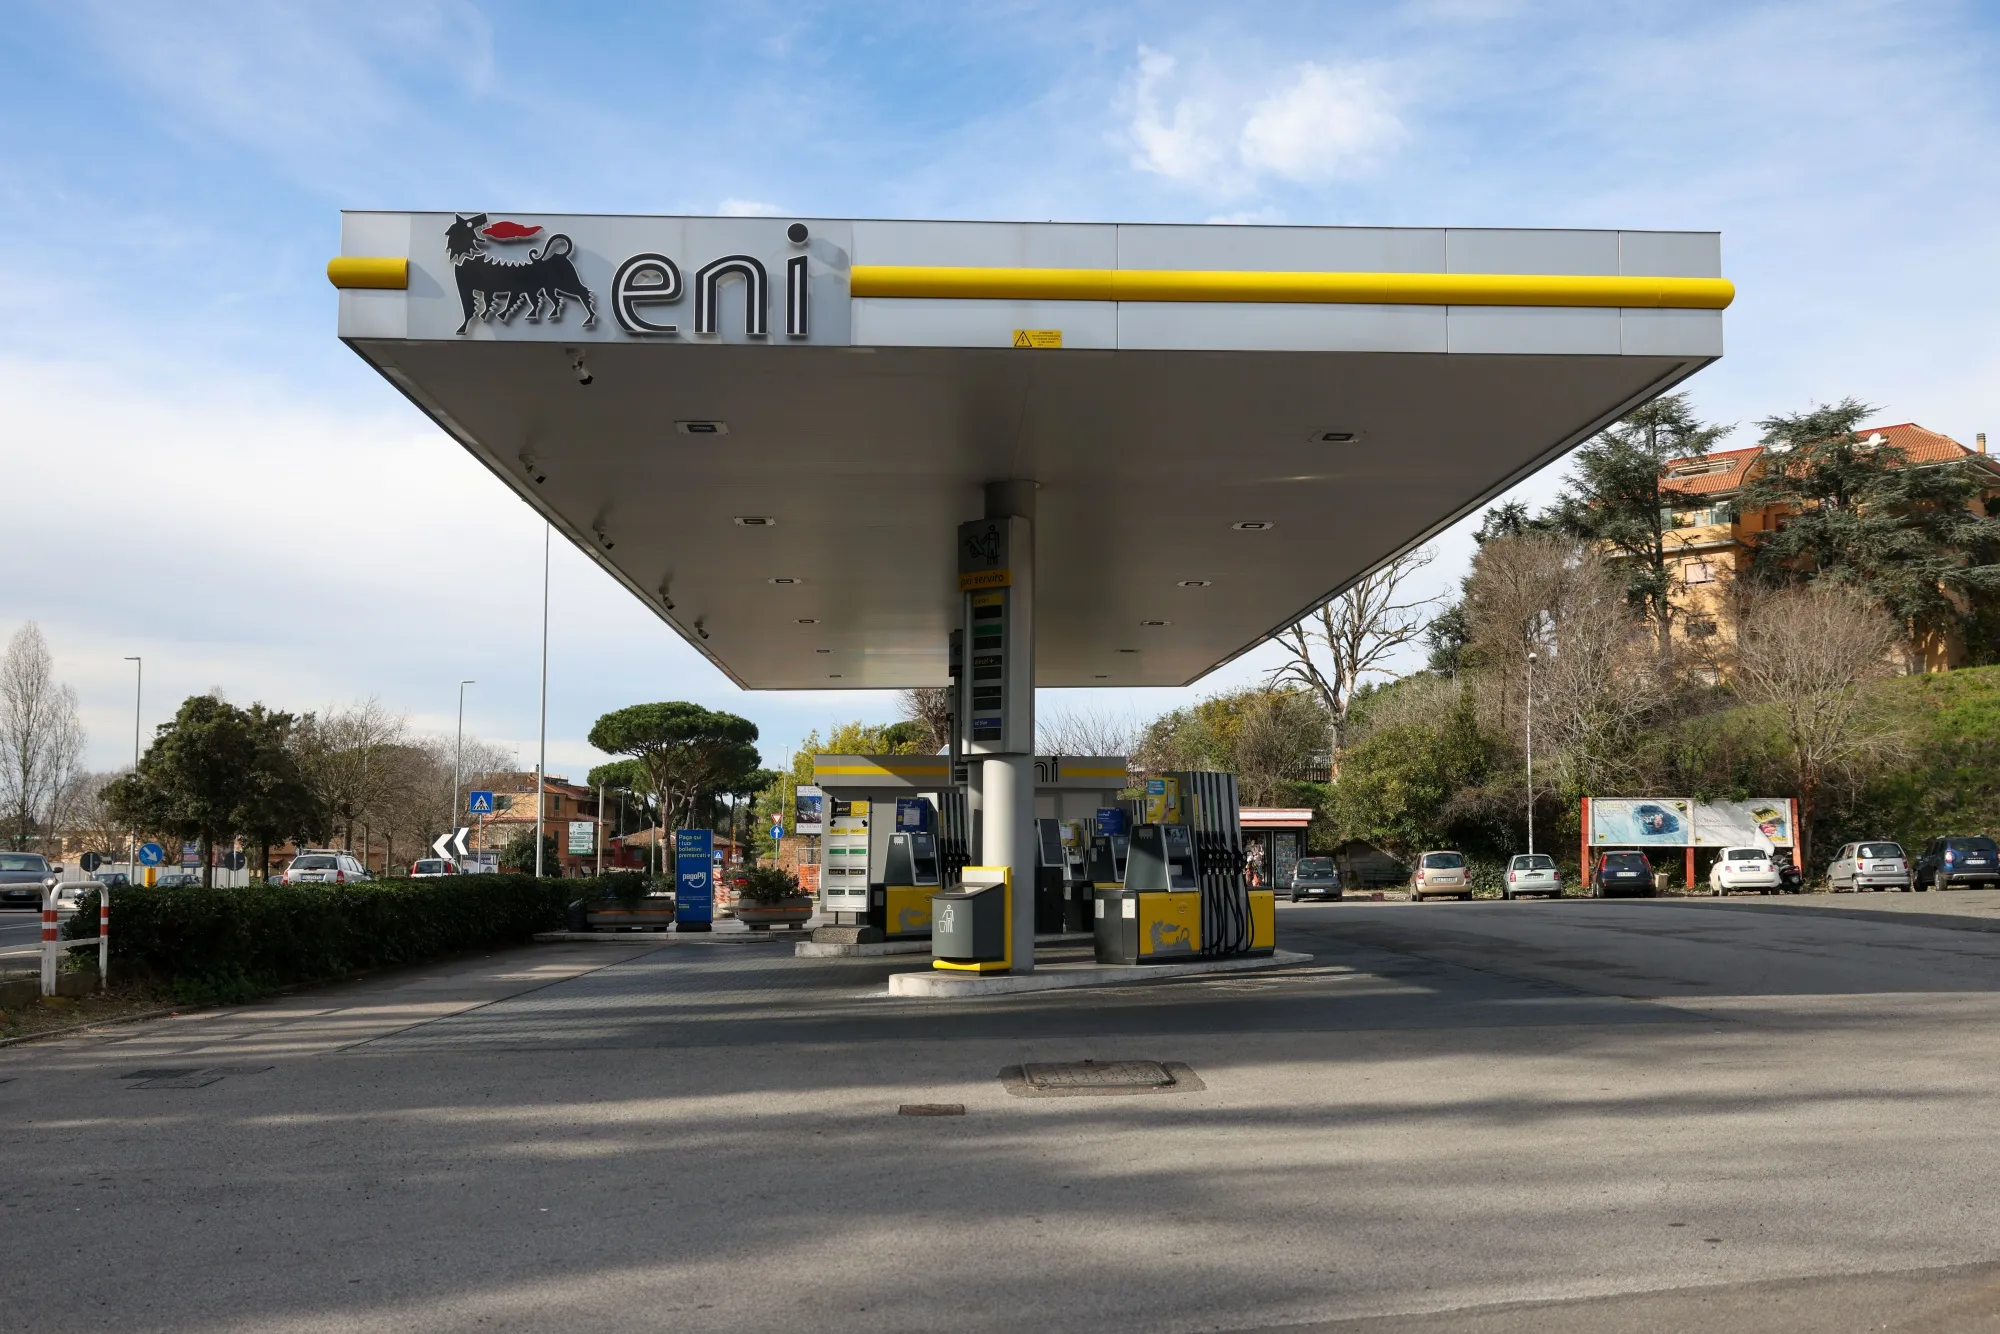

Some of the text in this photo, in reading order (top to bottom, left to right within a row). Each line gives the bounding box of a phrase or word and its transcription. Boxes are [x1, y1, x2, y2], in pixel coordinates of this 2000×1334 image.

[611, 223, 809, 335] eni
[1034, 756, 1058, 783] ni
[679, 834, 692, 842] Paga
[682, 872, 706, 882] pagoPA
